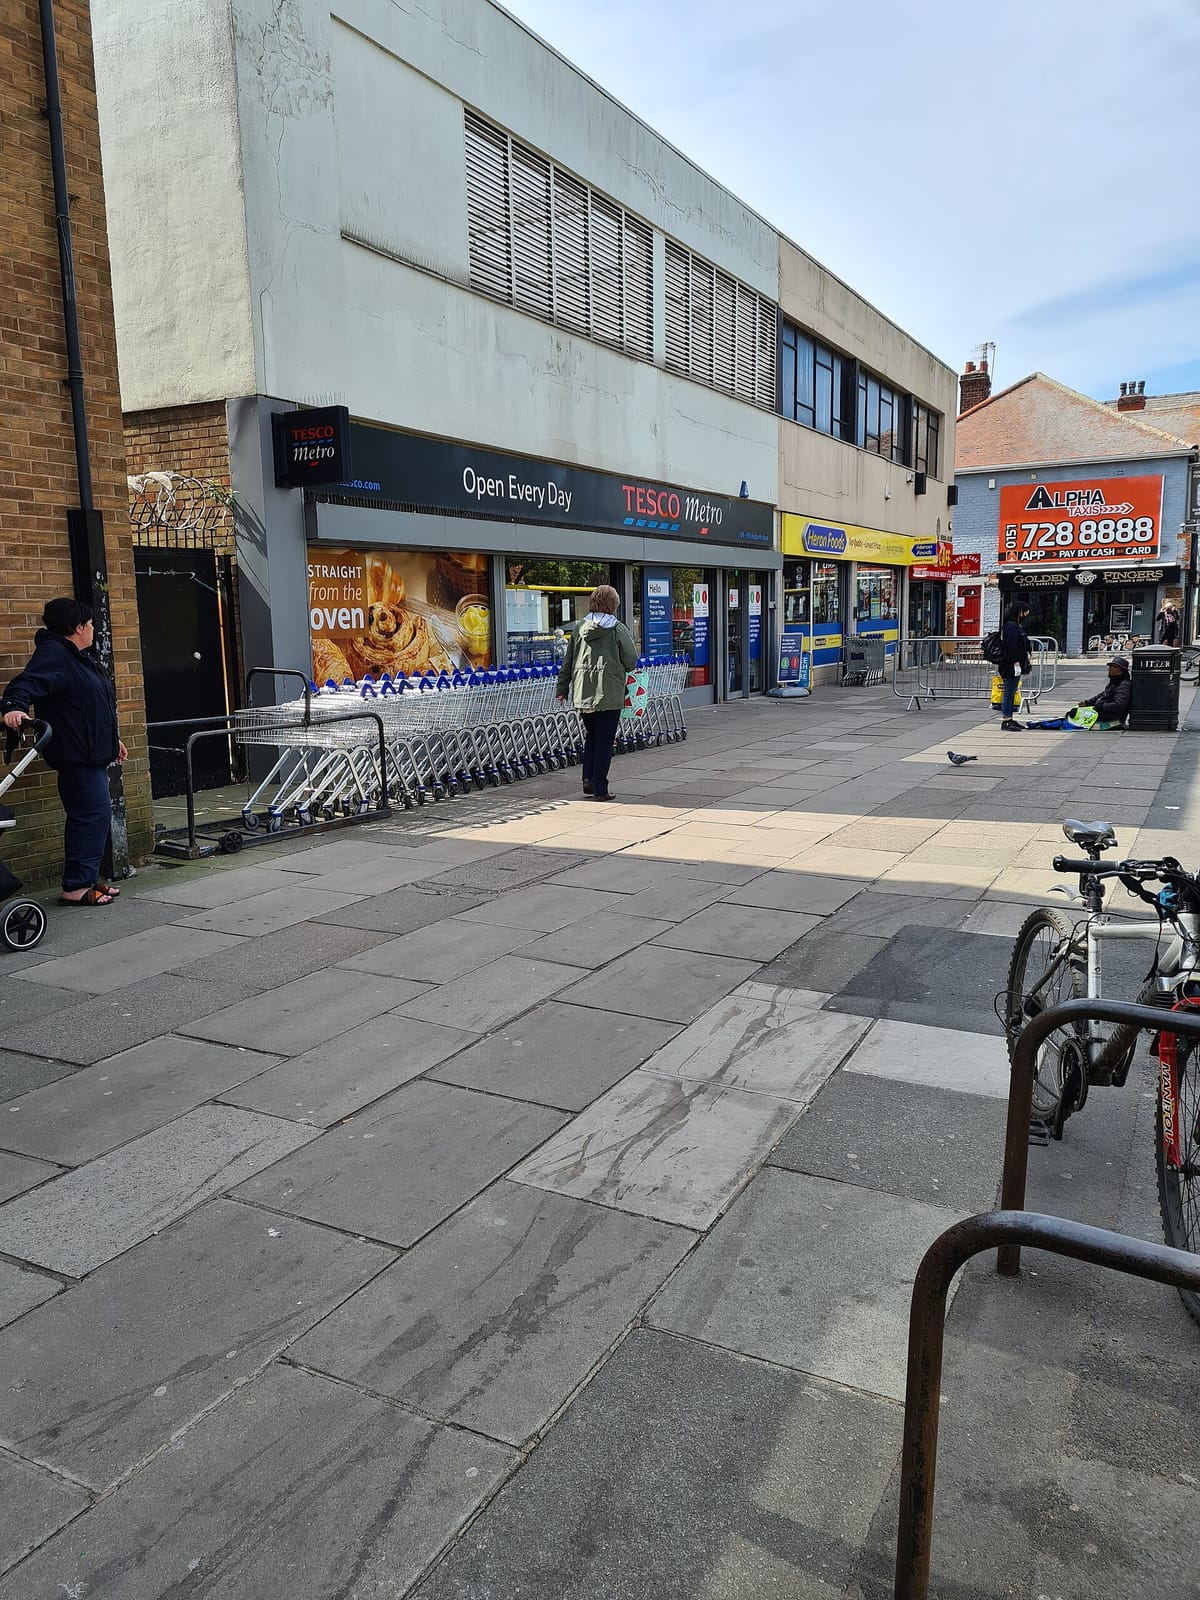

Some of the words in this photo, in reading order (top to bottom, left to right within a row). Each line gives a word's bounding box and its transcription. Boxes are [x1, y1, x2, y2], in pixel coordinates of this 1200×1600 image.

[292, 426, 334, 440] TESCO
[463, 467, 505, 500] Open
[508, 474, 545, 509] Every
[548, 481, 572, 512] Day
[622, 484, 681, 519] TESCO
[1067, 504, 1101, 516] TAXIS
[808, 529, 827, 547] Heron
[827, 532, 845, 550] Foods
[1005, 524, 1017, 549] 0151
[1021, 521, 1074, 549] 728
[1079, 516, 1154, 545] 8888
[1020, 550, 1046, 561] APP
[1059, 550, 1076, 558] PAY
[1077, 549, 1090, 557] BY
[1091, 548, 1115, 556] CASH
[1125, 546, 1152, 555] CARD
[307, 564, 362, 579] STRAIGHT
[1014, 574, 1070, 584] GOLDEN
[1103, 570, 1164, 580] FINGERS
[309, 581, 339, 604] from
[343, 581, 363, 601] the
[649, 583, 662, 594] Hello
[310, 607, 365, 630] oven
